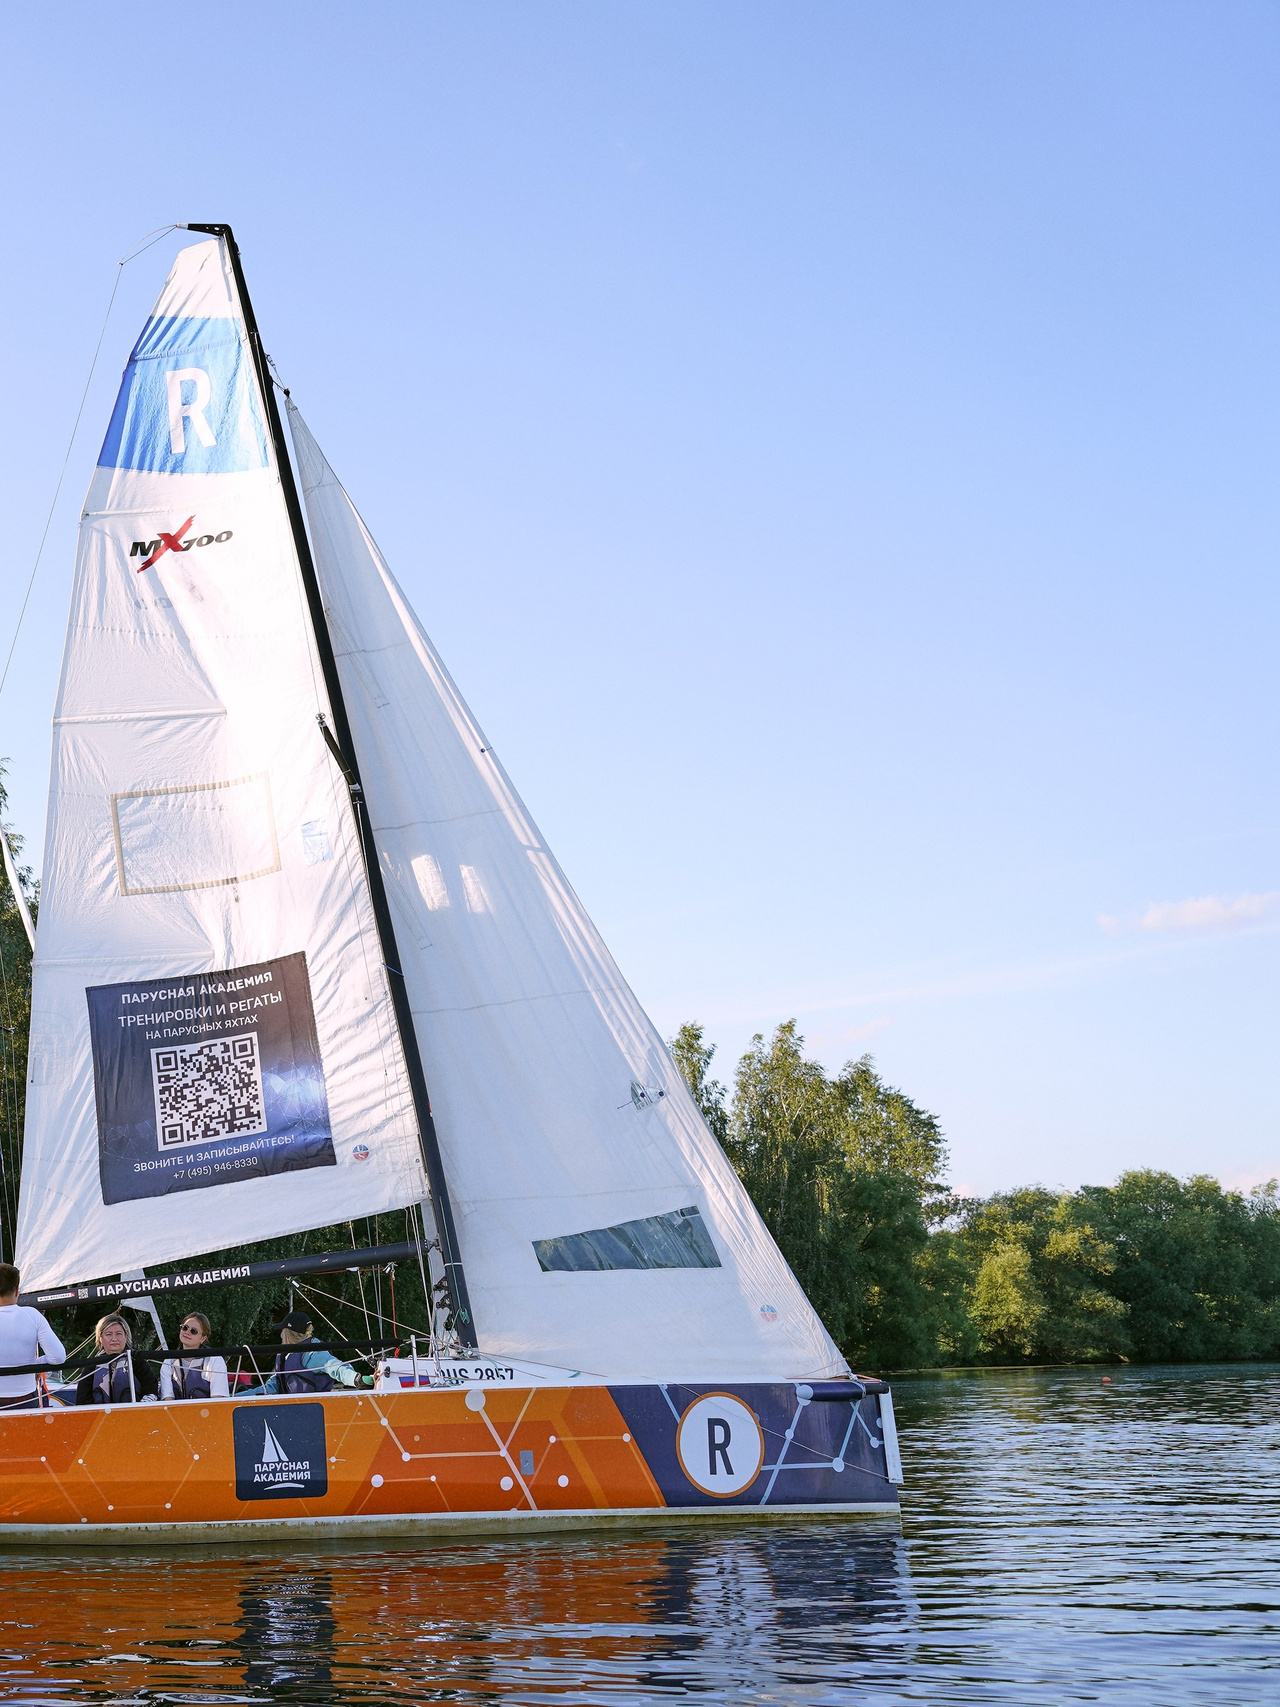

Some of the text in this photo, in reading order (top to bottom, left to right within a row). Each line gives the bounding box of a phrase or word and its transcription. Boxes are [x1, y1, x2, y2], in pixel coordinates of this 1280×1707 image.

[166, 367, 217, 454] R
[130, 514, 233, 573] MX700
[121, 972, 273, 1004] ПАРУСНАЯ АКАДЕМИЯ
[118, 991, 282, 1027] ТРЕНИРОВКИ И РЕГАТЫ
[145, 1014, 259, 1040] НА ПАРУСНЫХ ЯХТАХ
[133, 1134, 296, 1172] ЗВОНИТЕ И ЗАПИСЫВАЙТЕСЬ!
[173, 1156, 258, 1179] +7 (495) 946-8330
[96, 1266, 250, 1297] ПАРУСНАЯ АКАДЕМИЯ
[708, 1418, 734, 1475] R
[253, 1471, 311, 1483] АКАДЕМИЯ
[254, 1461, 310, 1473] ПАРУСНАЯ
